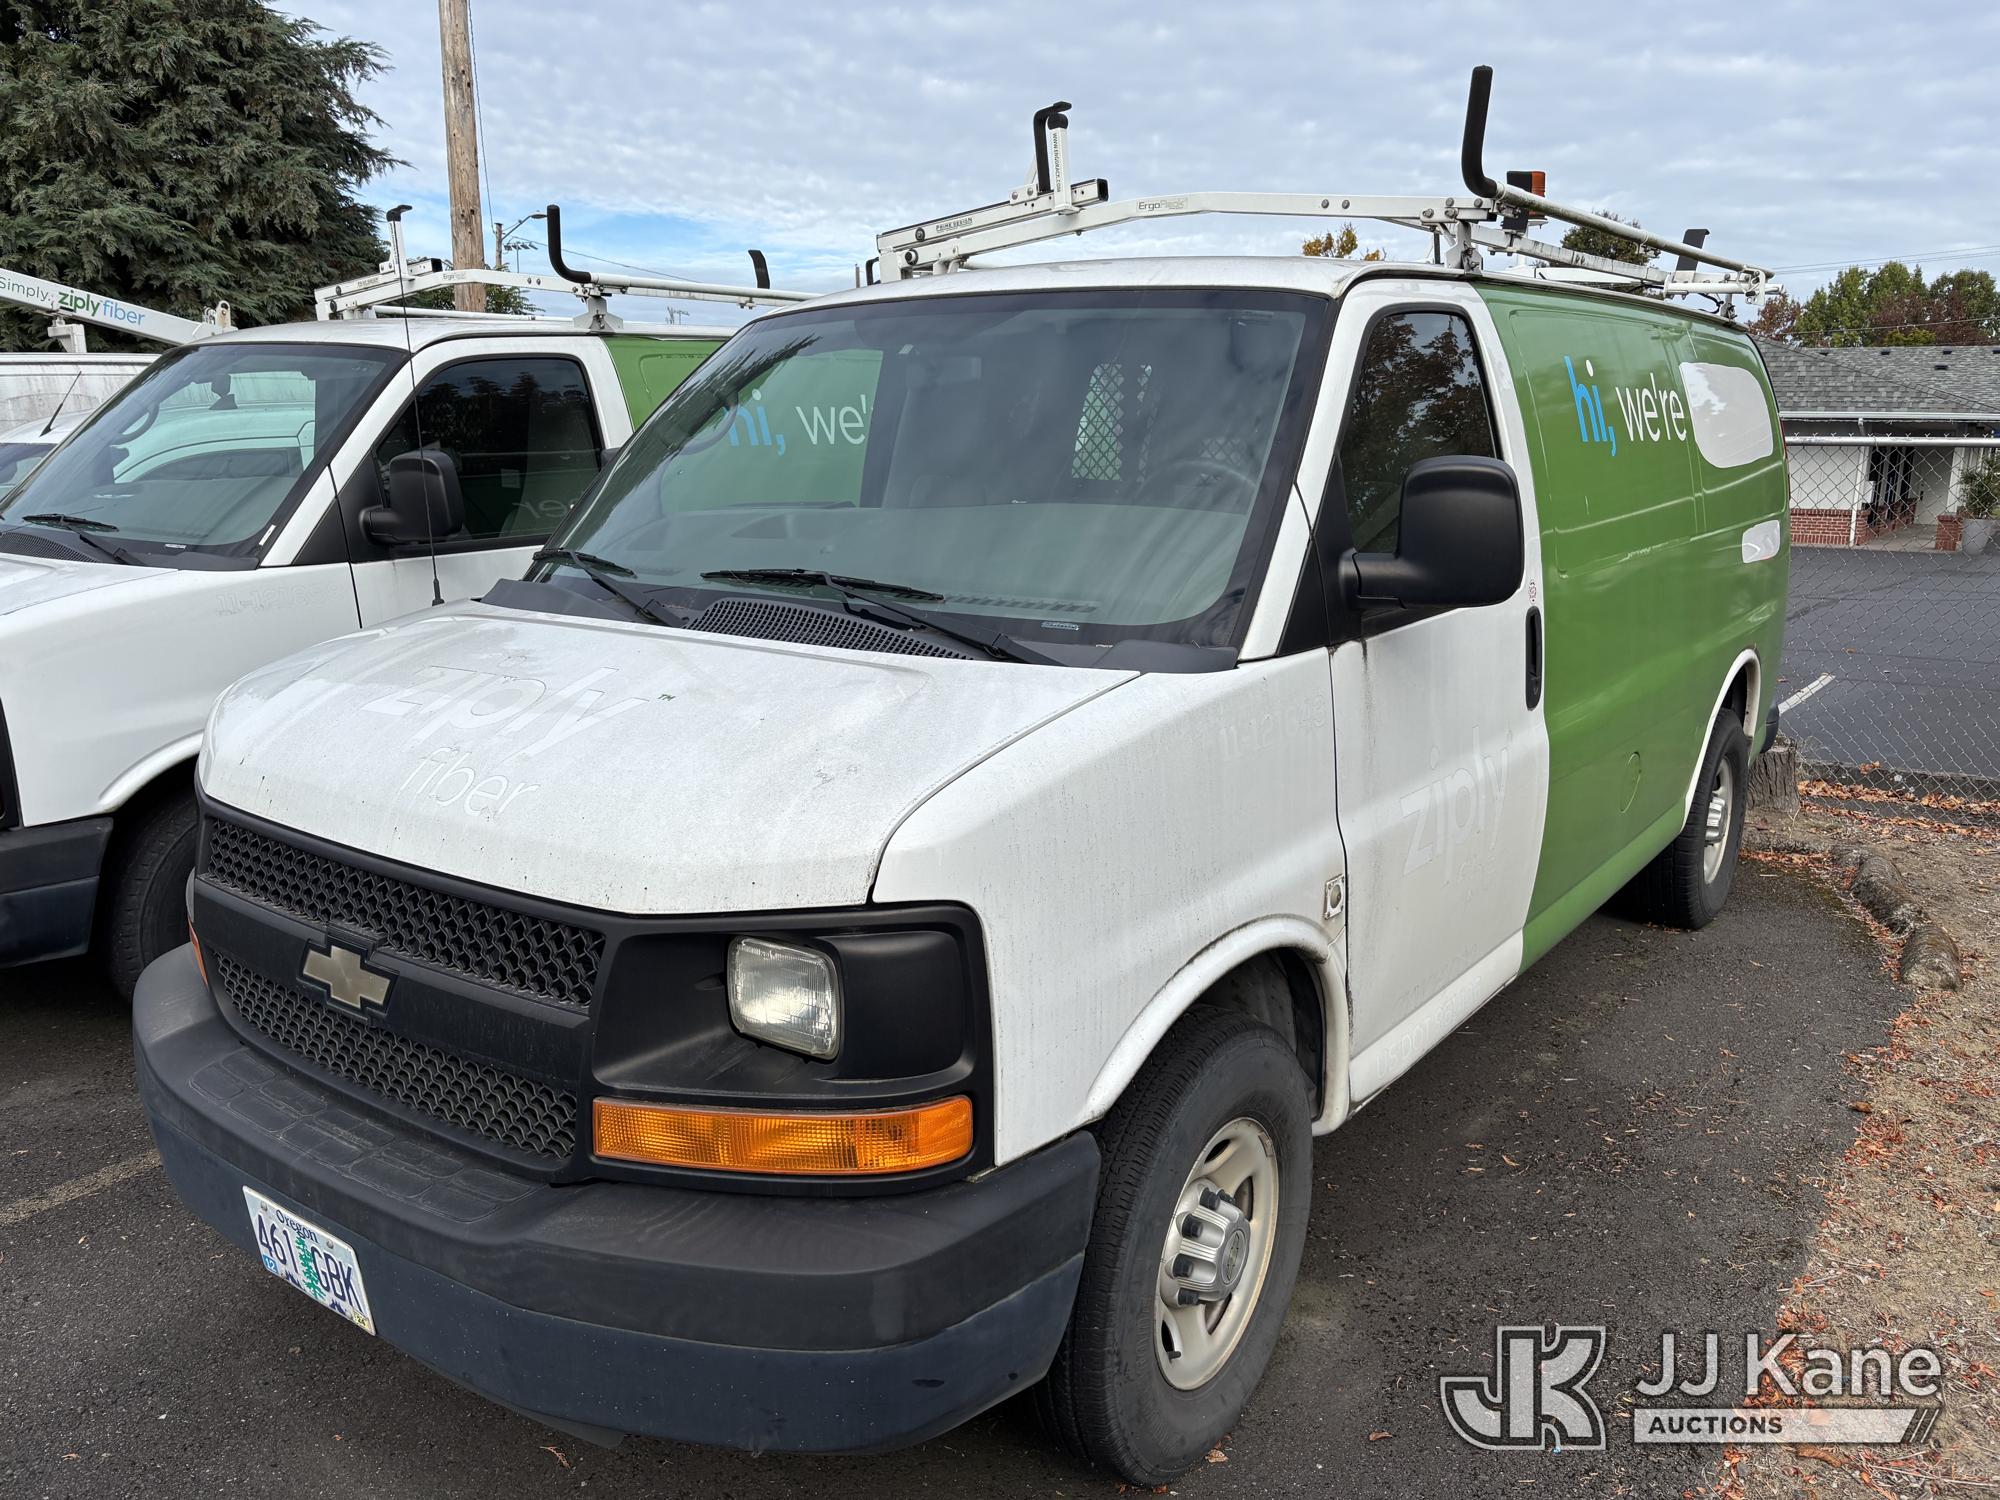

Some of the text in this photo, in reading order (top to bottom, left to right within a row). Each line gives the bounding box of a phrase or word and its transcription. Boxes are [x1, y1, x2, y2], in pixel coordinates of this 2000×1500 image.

[58, 289, 101, 316] ziply
[103, 299, 146, 325] fiber
[1564, 355, 1687, 456] hi, we're
[400, 746, 541, 817] fiber
[275, 1209, 318, 1243] Oregon
[257, 1214, 363, 1313] 461 GBK
